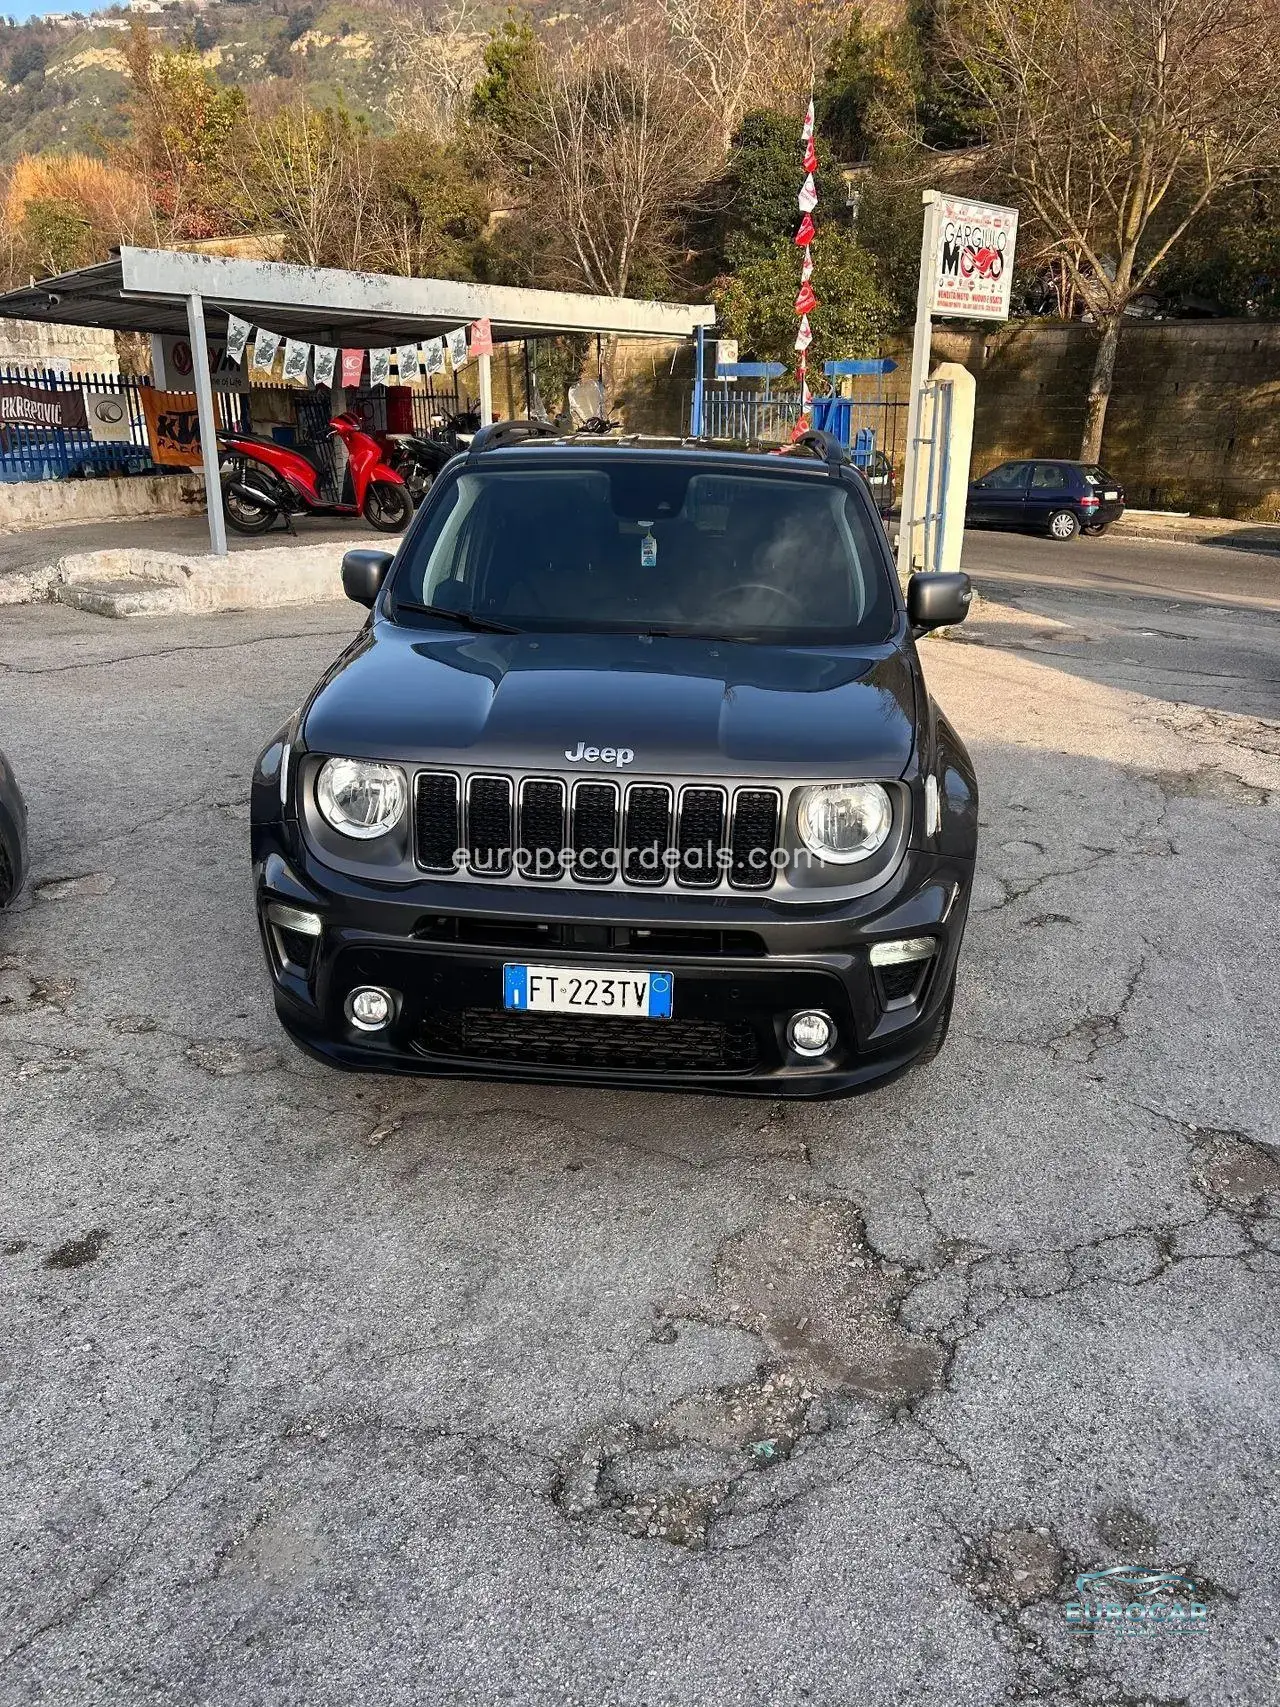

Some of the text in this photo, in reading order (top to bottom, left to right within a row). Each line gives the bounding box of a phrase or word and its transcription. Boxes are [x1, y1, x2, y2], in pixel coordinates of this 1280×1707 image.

[564, 741, 635, 768] Jeep
[528, 976, 648, 1009] FT 223TV
